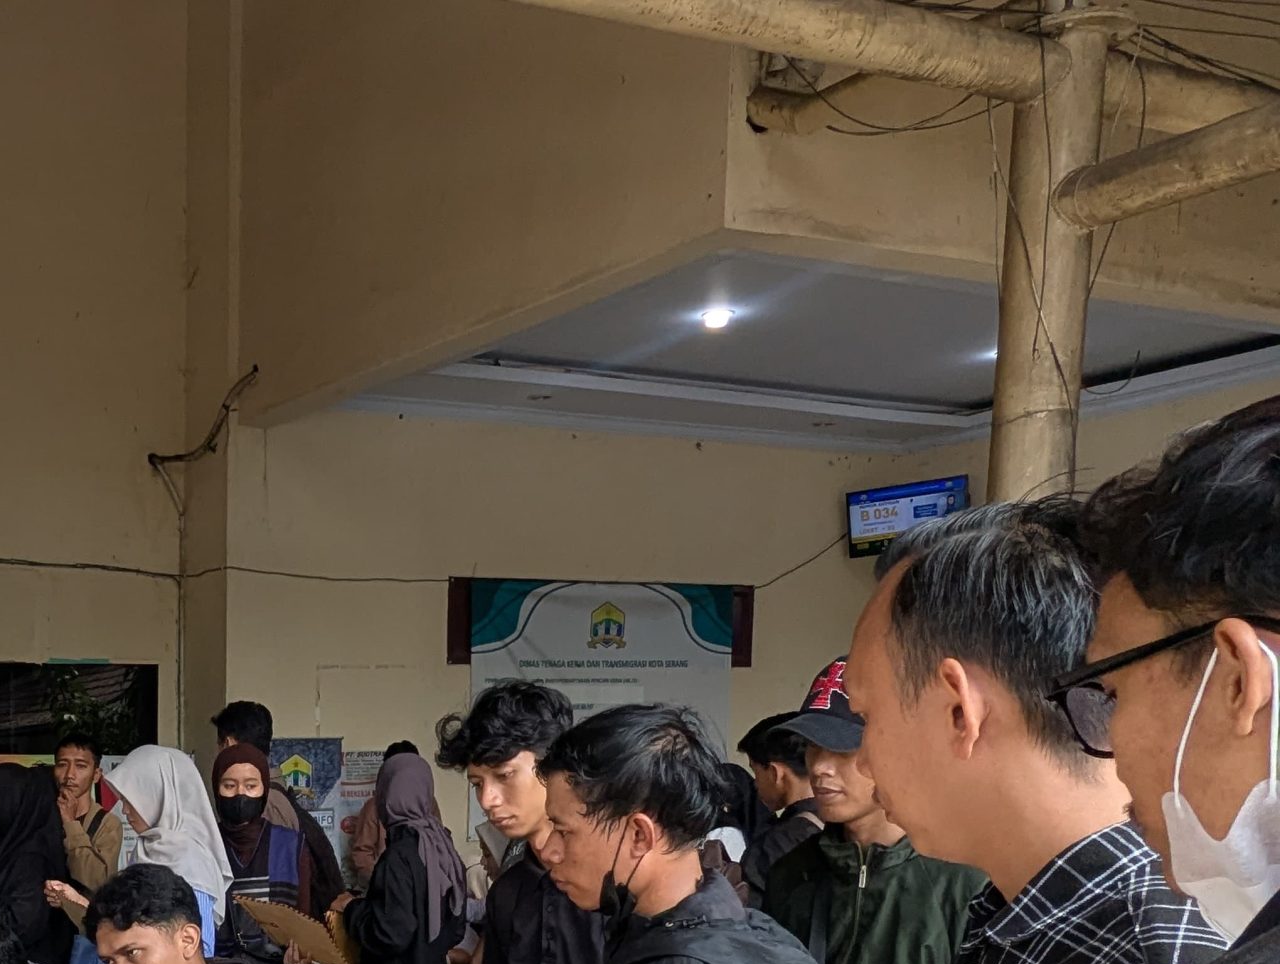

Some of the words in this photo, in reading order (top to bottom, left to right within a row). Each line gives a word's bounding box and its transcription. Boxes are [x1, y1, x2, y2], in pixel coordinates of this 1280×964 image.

[541, 660, 566, 668] TENAGA
[587, 660, 601, 668] DAN
[601, 660, 647, 668] TRANSMIGRASI
[648, 660, 664, 668] KOTA
[664, 660, 689, 668] SERANG
